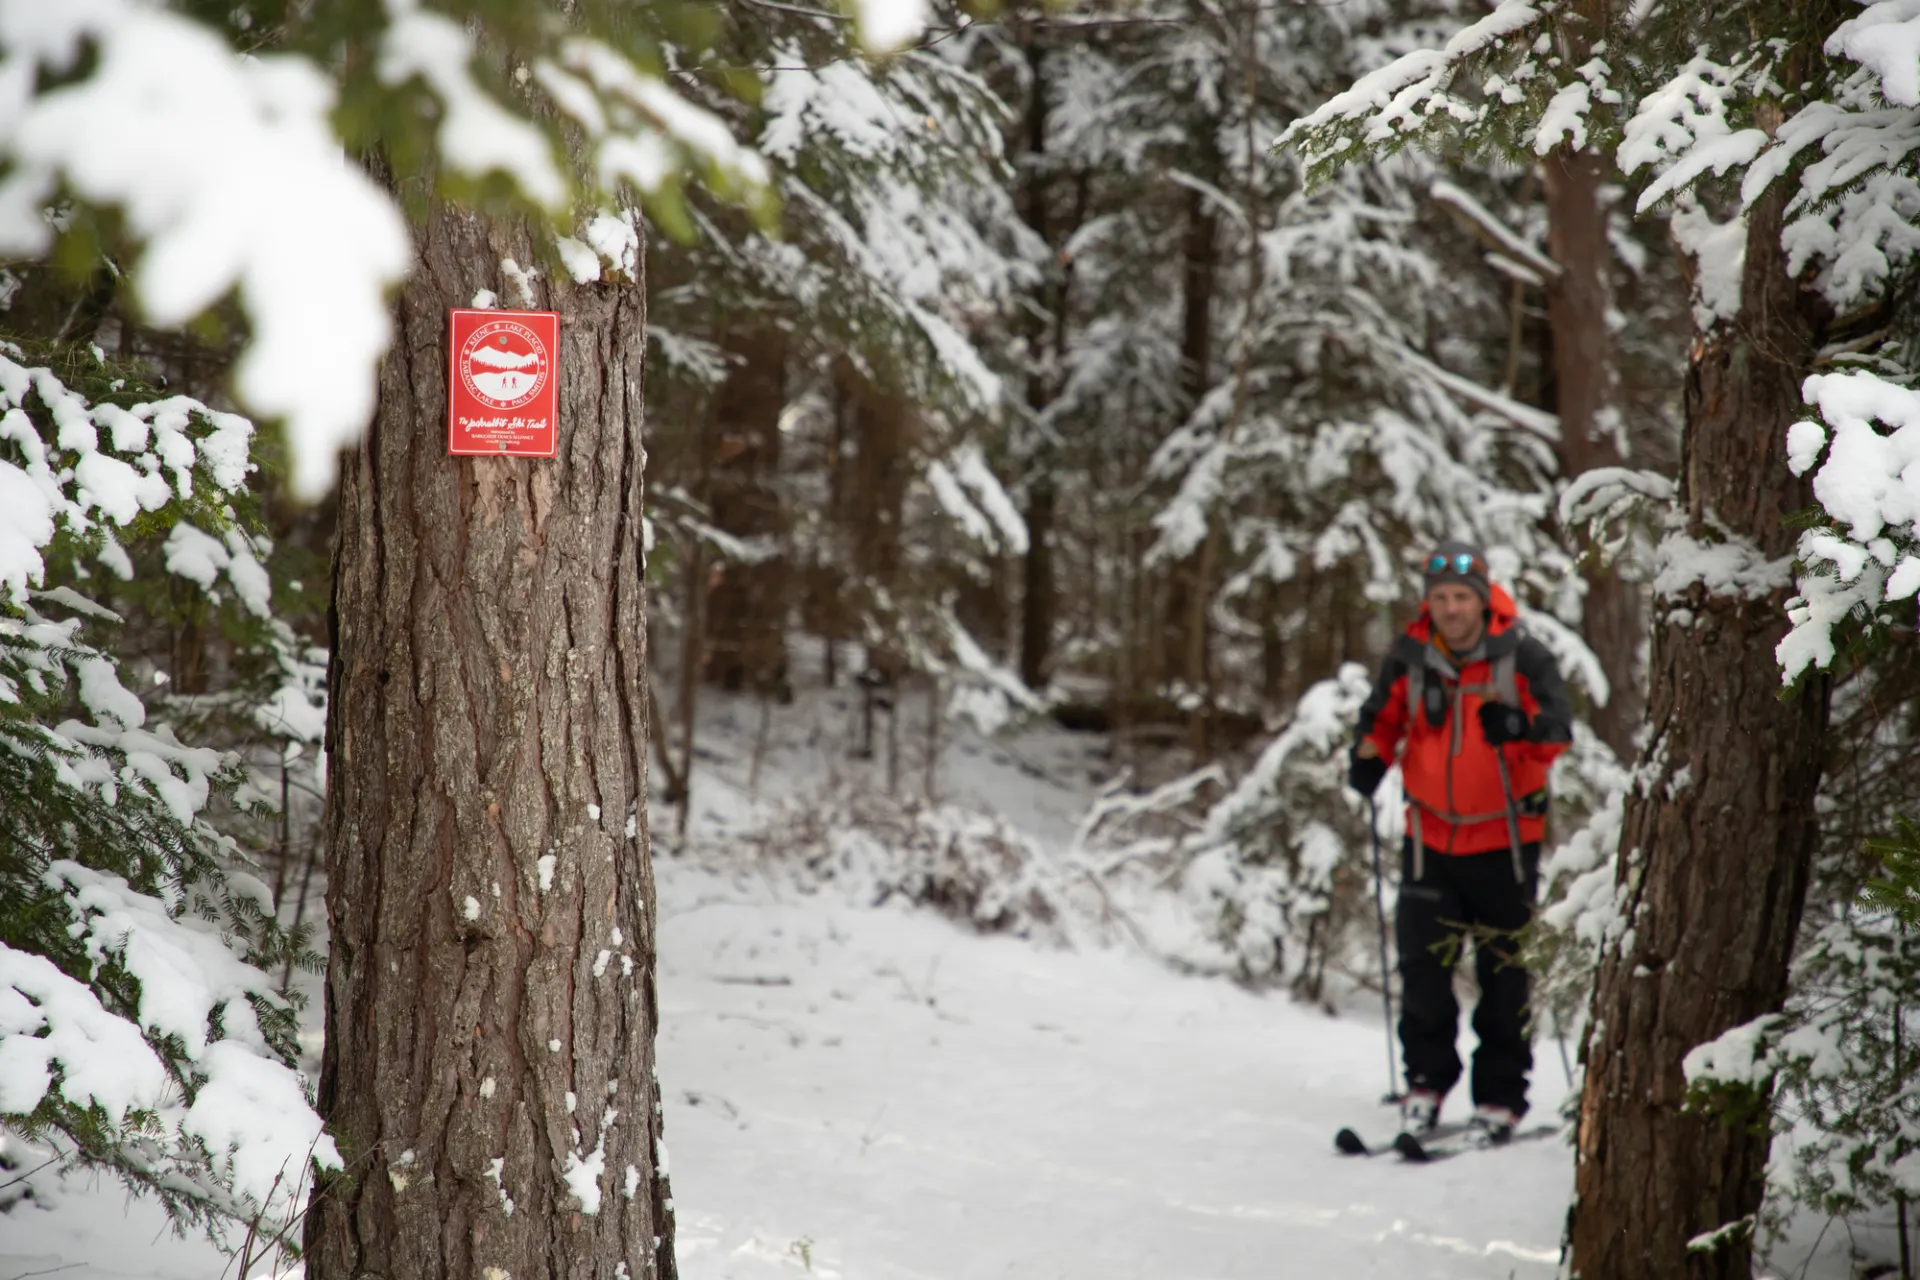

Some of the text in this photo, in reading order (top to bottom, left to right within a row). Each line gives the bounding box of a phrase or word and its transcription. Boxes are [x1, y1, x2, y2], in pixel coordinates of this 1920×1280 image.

[469, 327, 489, 346] KEENE
[505, 323, 543, 354] LAKE PLACID
[462, 360, 494, 405] SARANAC LAKE
[511, 371, 545, 406] PAUL SMITHS
[507, 417, 525, 429] Ski
[526, 418, 547, 430] Trail
